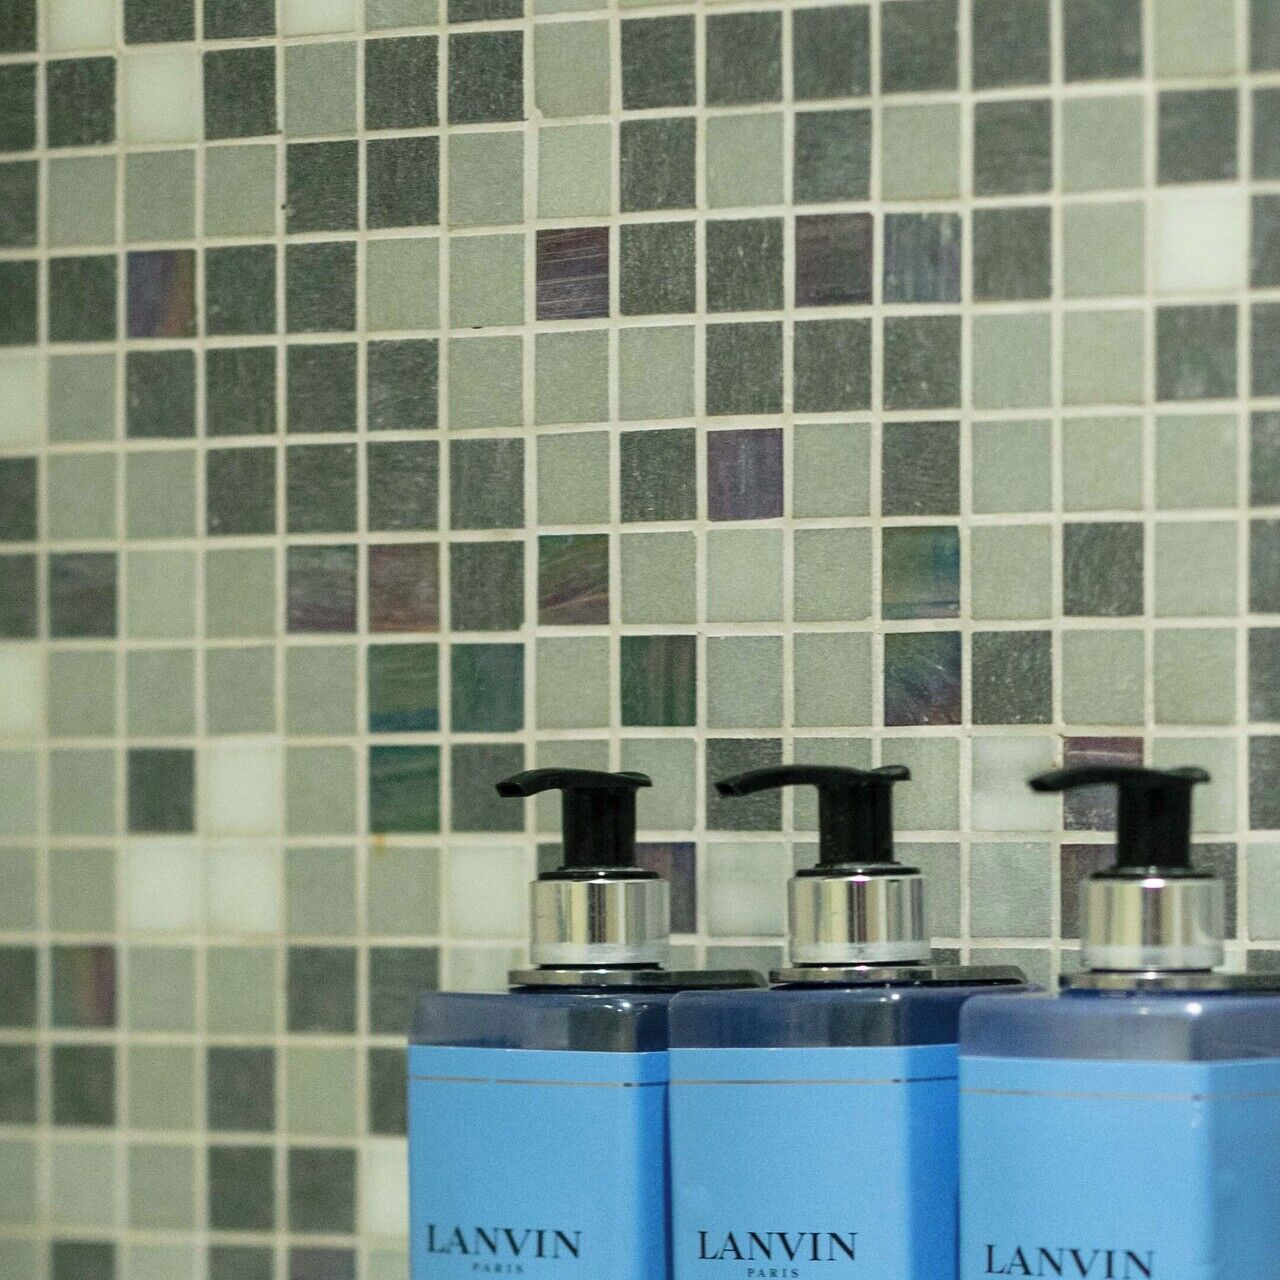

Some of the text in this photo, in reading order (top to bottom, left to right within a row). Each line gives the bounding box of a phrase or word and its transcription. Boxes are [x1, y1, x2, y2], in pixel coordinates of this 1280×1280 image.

[427, 1224, 583, 1259] LANVIN
[697, 1230, 859, 1262] LANVIN
[746, 1267, 800, 1279] PARIS
[984, 1243, 1154, 1280] LANVIN
